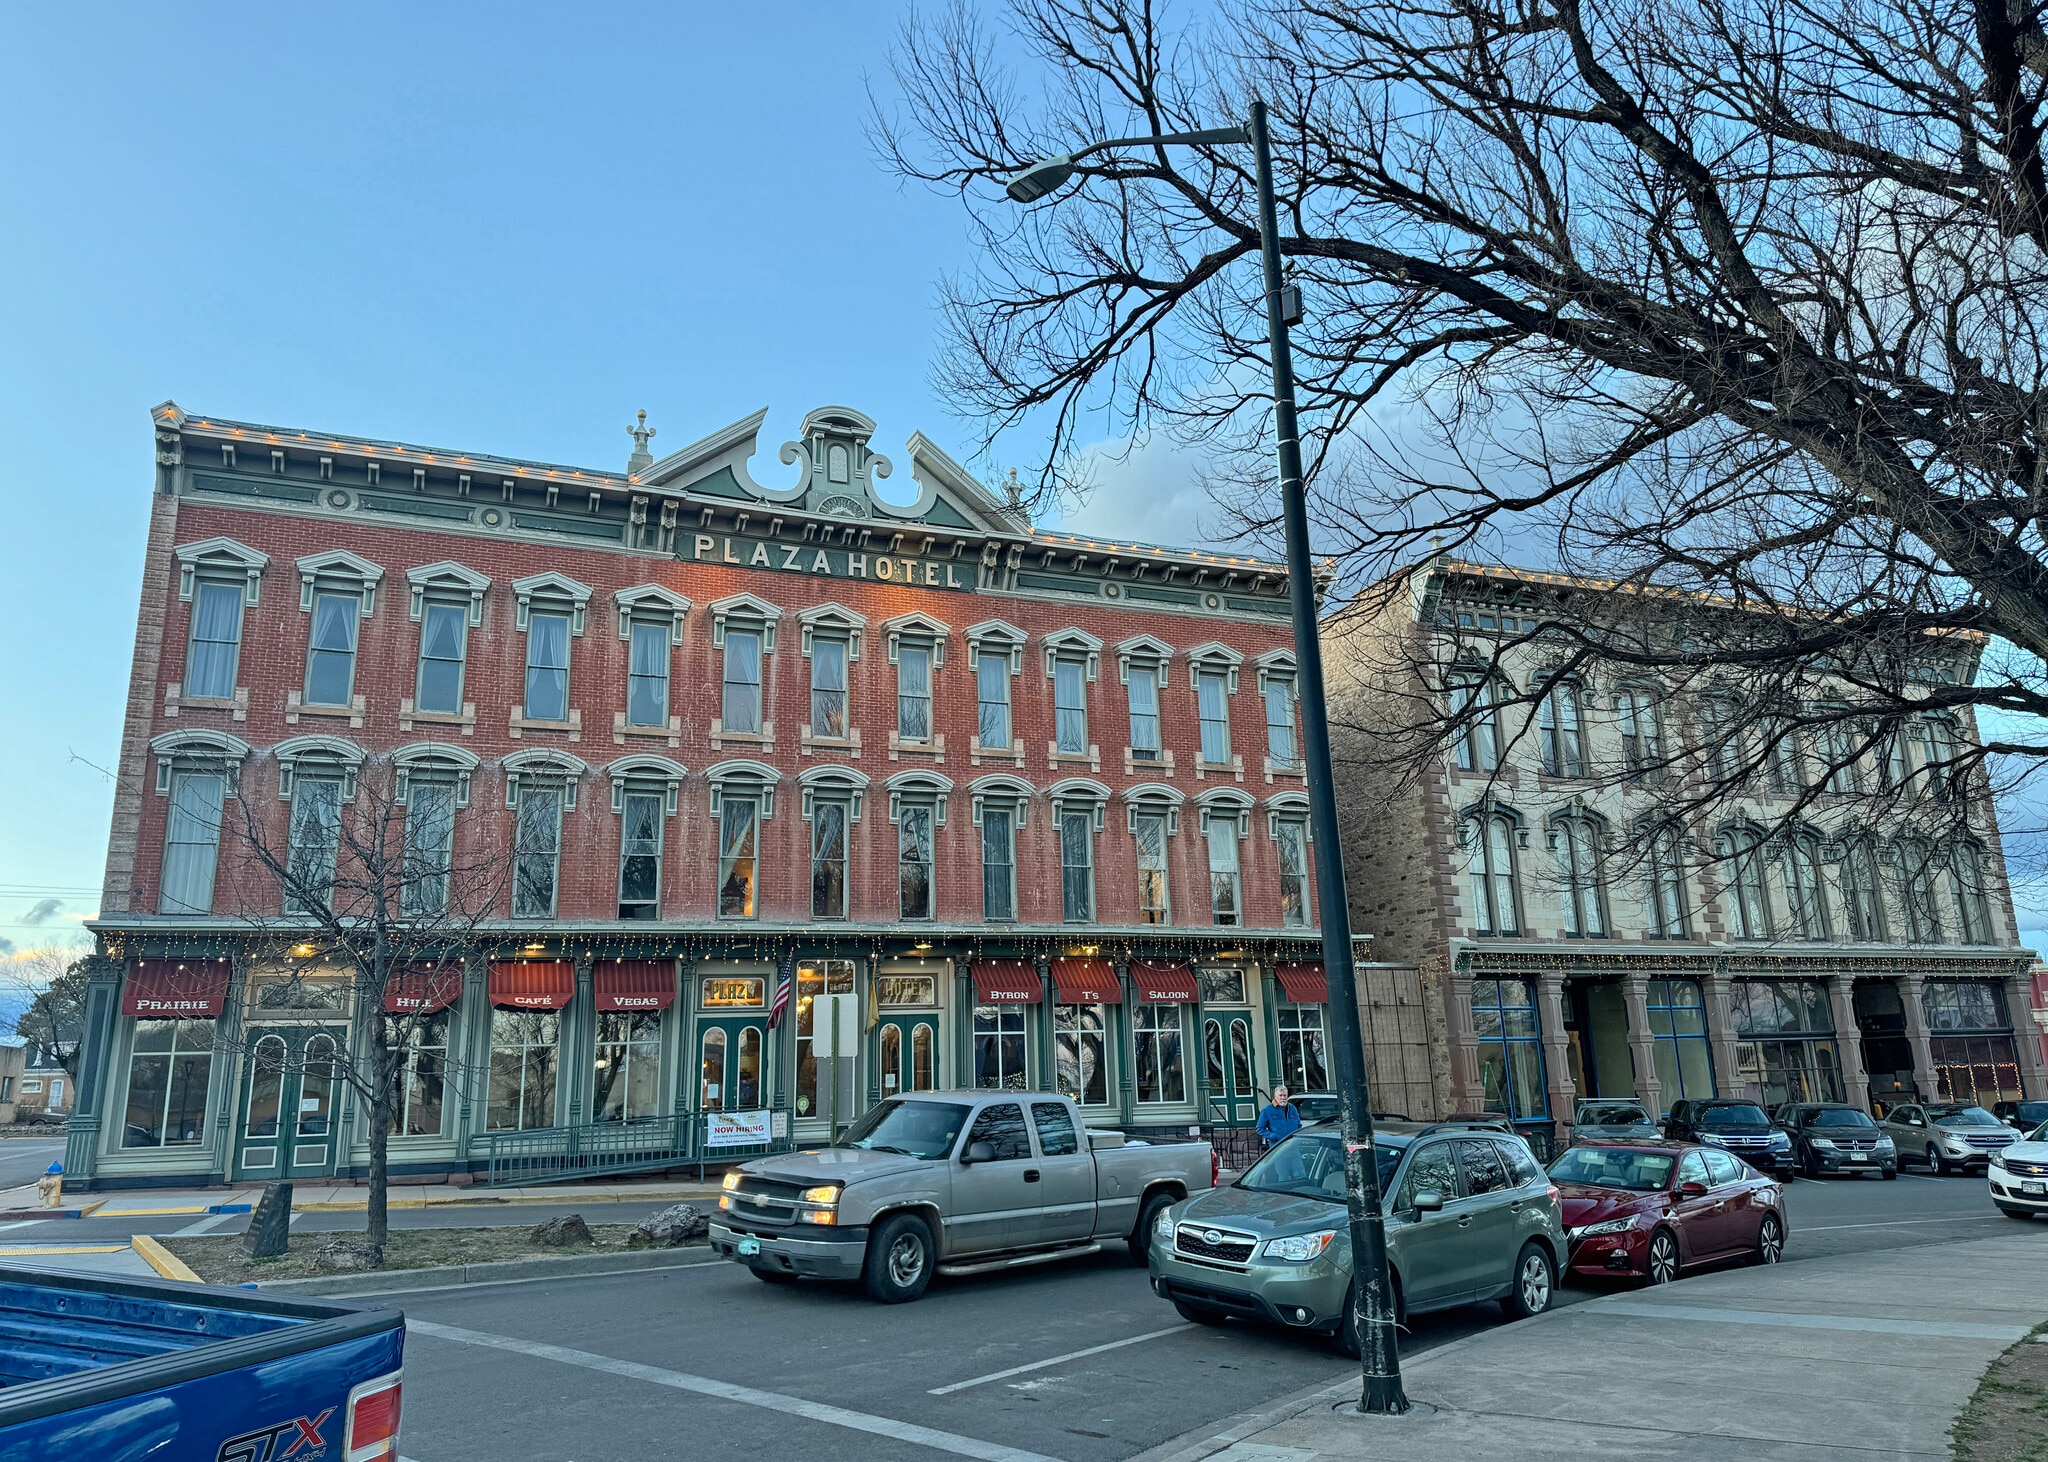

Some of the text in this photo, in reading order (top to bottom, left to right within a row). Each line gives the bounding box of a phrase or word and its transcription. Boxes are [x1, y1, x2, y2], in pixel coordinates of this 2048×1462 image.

[694, 533, 961, 588] PLAZA HOTEL
[885, 981, 926, 996] HOTEL
[990, 990, 1029, 1000] BYRON
[1148, 990, 1190, 1000] SALOON
[613, 997, 659, 1006] VEGAS
[736, 1125, 764, 1134] HIRING
[215, 1405, 339, 1462] STX
